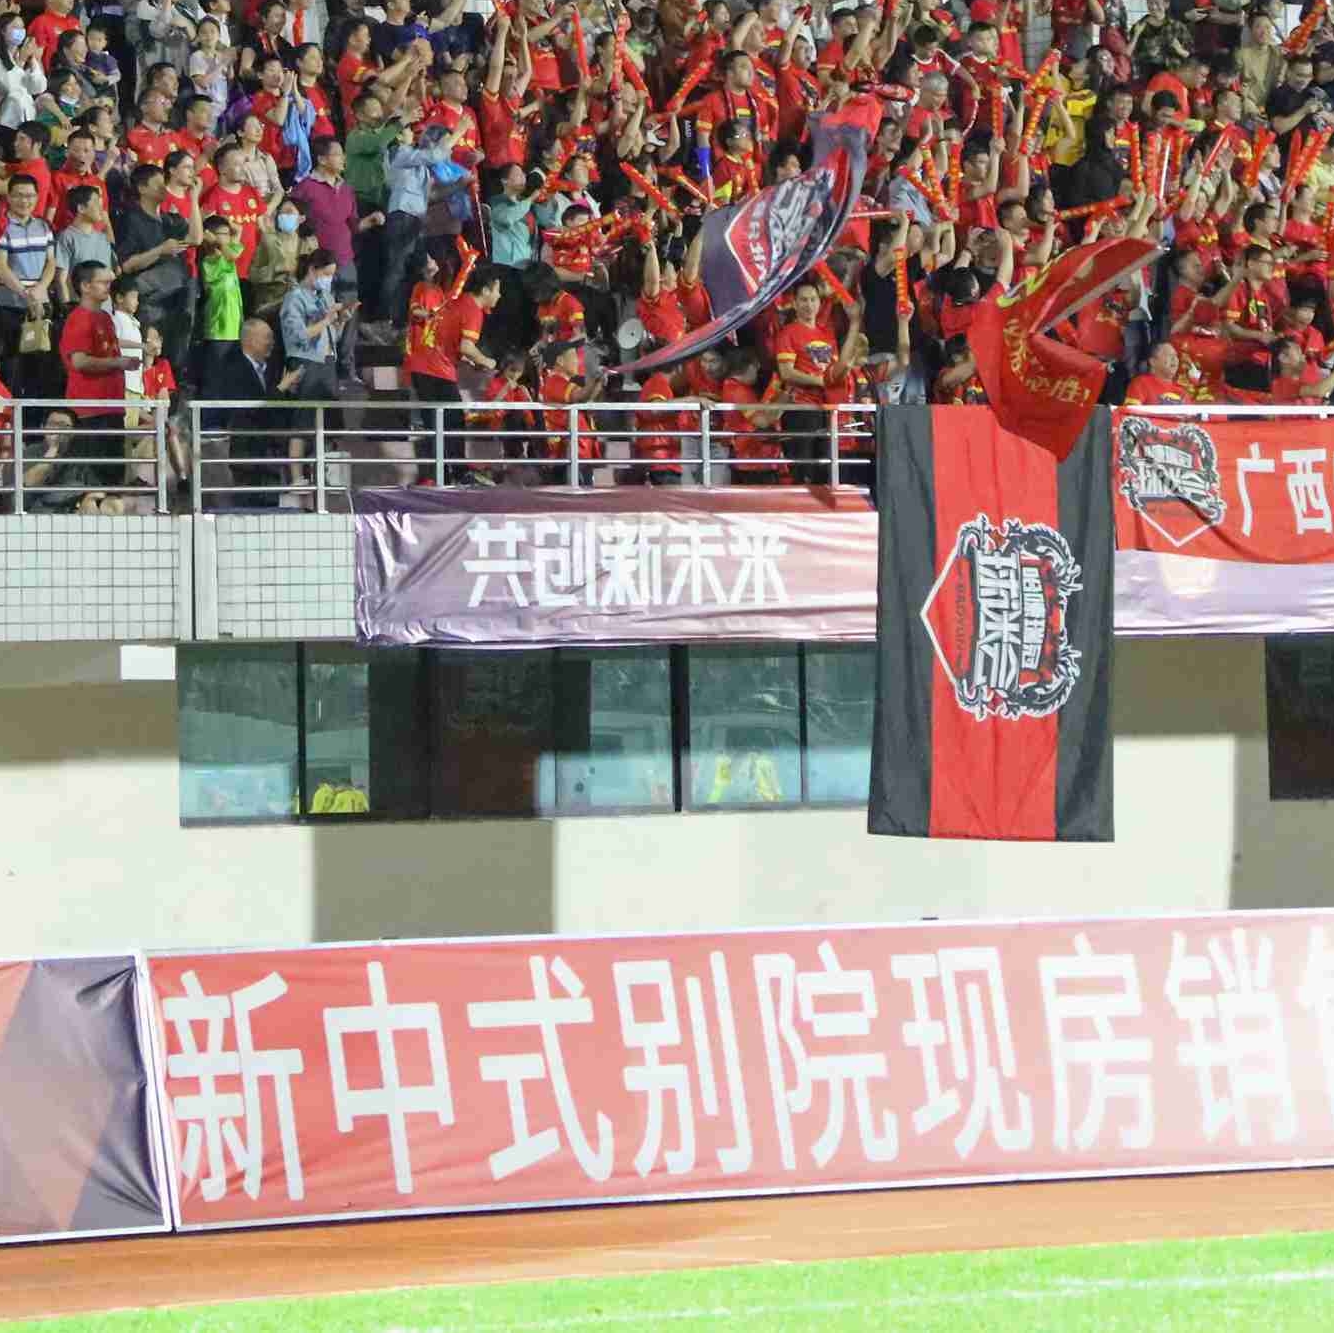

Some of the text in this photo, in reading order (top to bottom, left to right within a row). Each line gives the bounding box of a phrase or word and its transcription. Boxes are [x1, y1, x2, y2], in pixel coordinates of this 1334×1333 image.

[463, 519, 791, 608] 共创新未来
